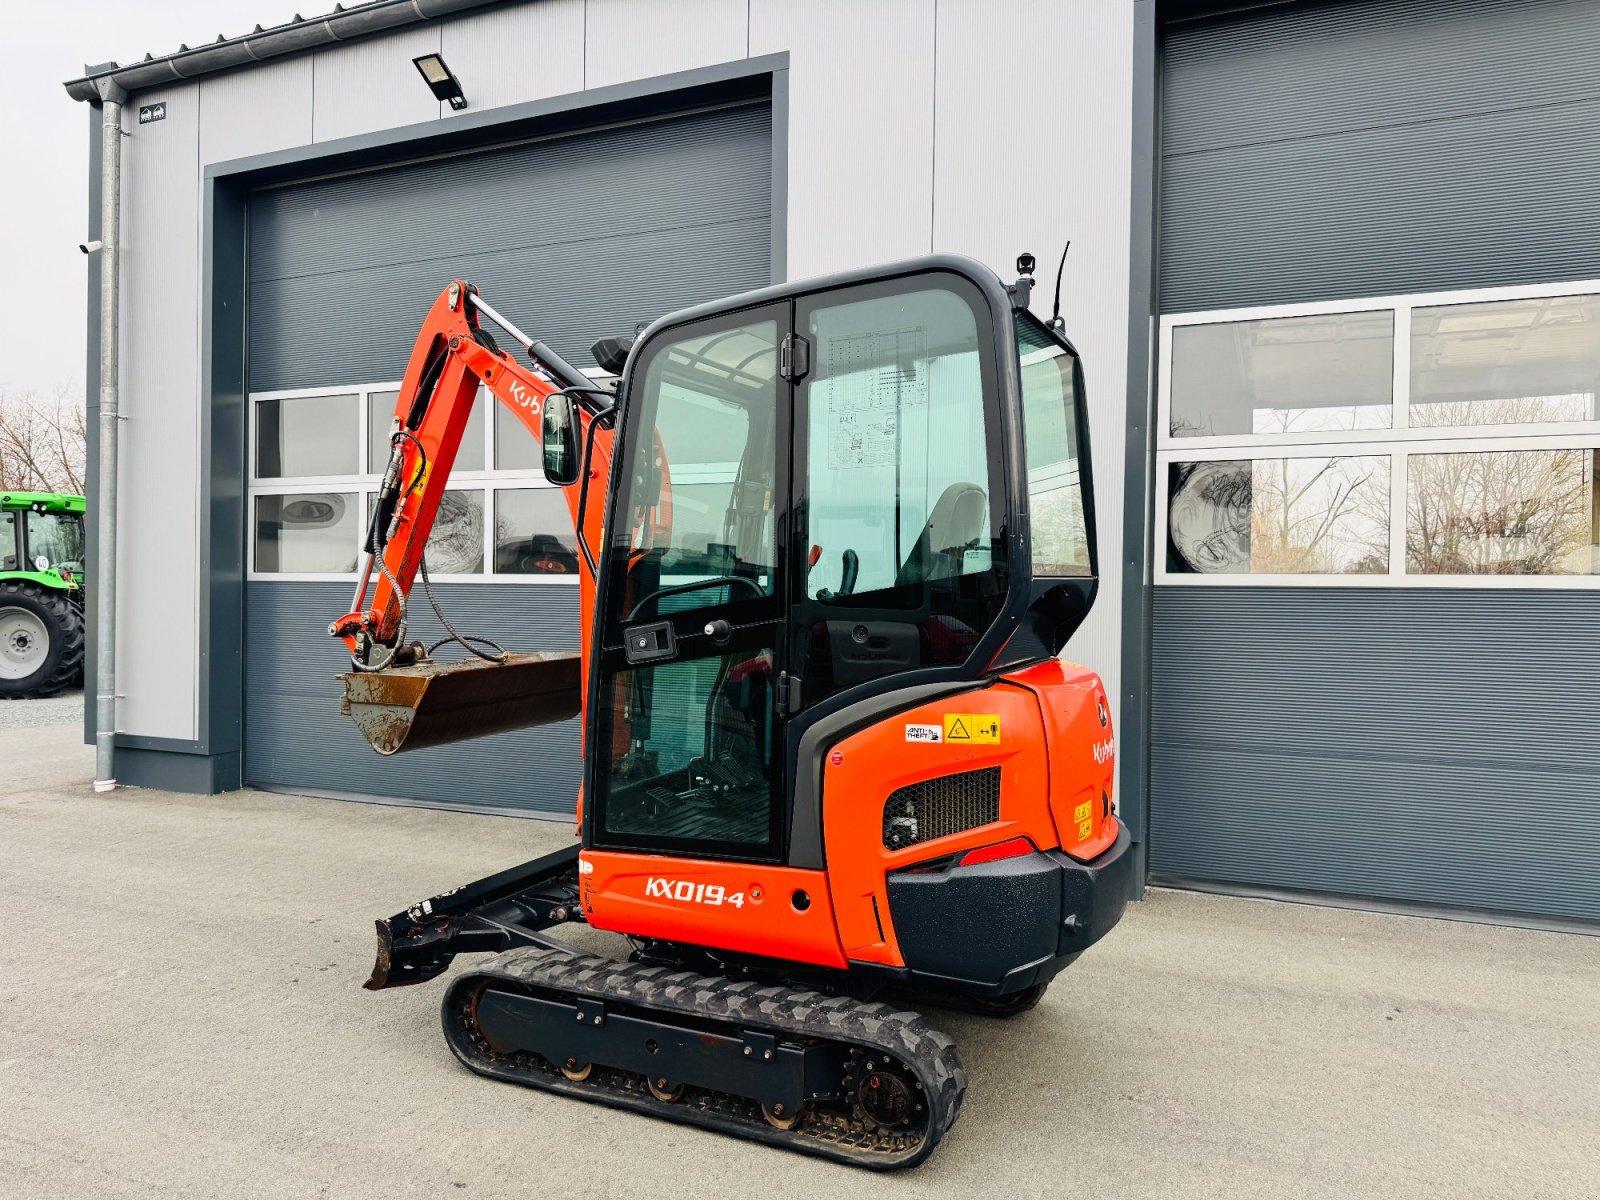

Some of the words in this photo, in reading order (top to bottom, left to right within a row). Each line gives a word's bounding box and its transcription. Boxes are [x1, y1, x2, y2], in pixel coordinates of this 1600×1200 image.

[508, 379, 542, 415] Kub
[38, 558, 47, 569] 40
[645, 877, 745, 908] KX019-4
